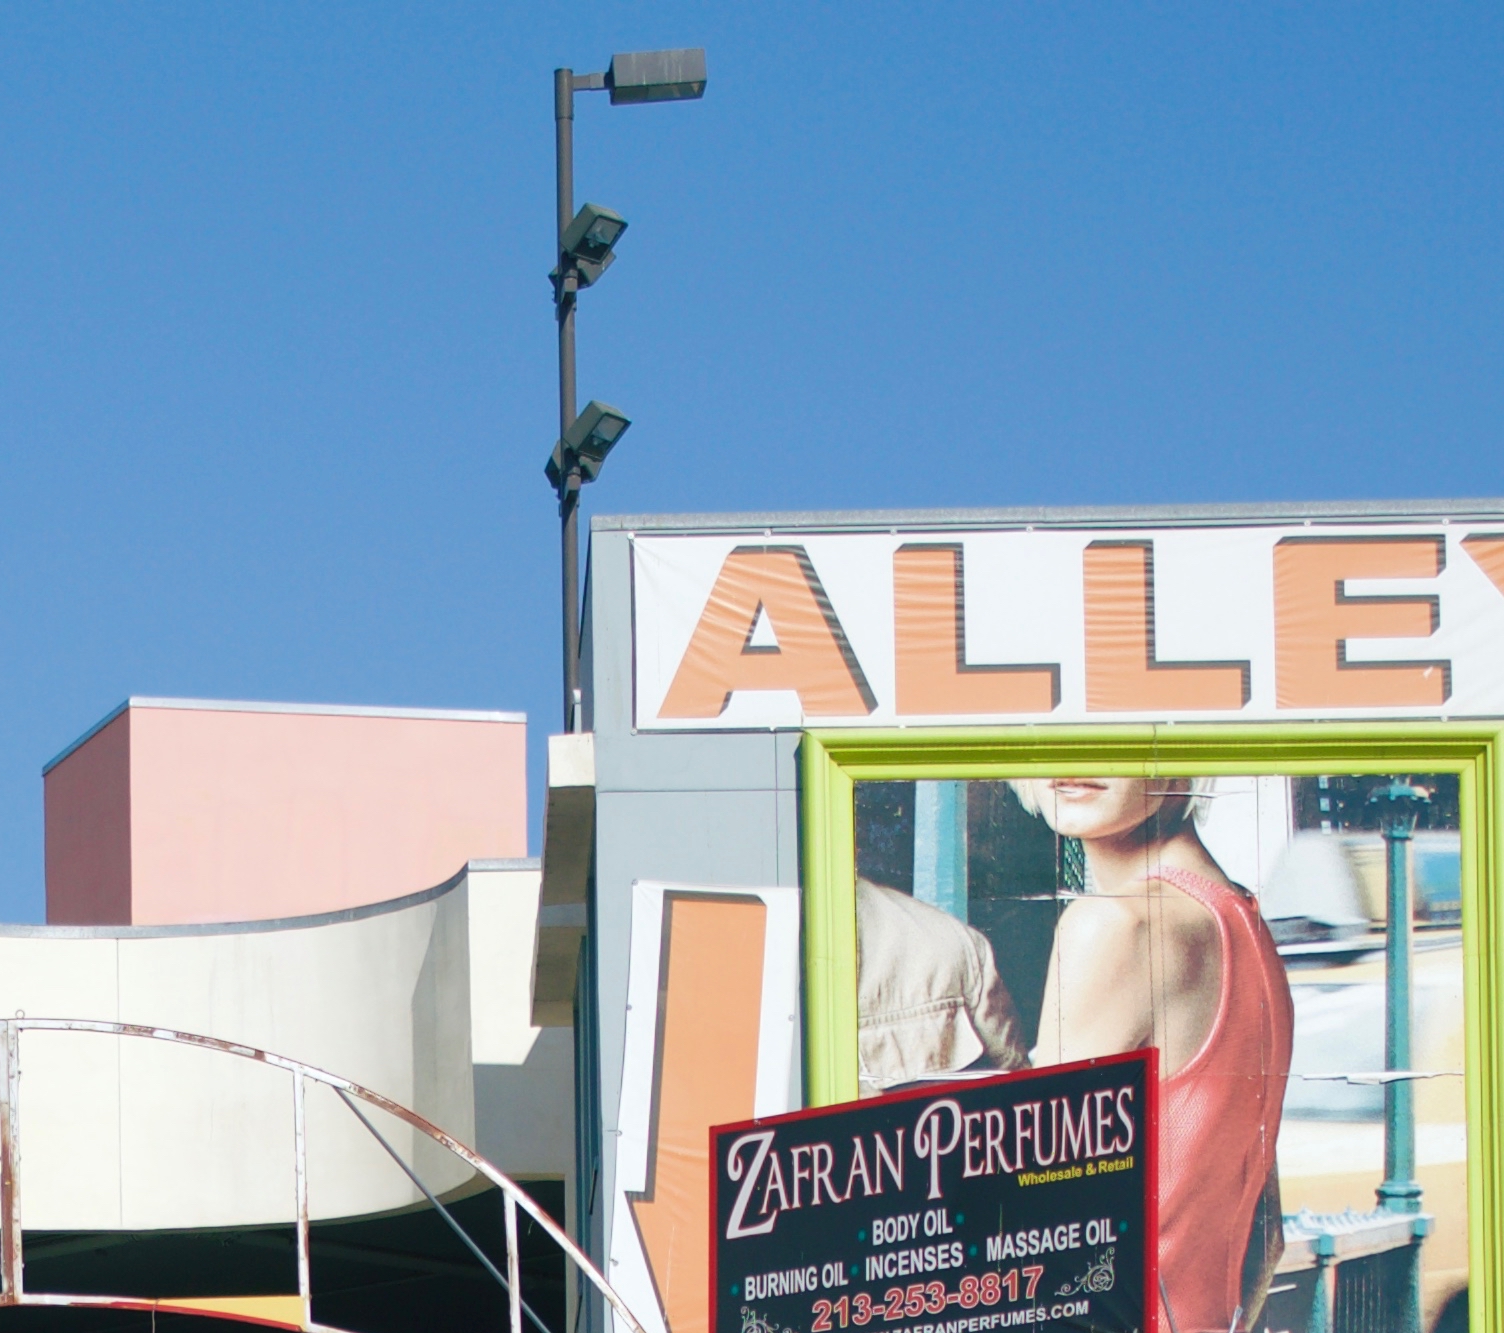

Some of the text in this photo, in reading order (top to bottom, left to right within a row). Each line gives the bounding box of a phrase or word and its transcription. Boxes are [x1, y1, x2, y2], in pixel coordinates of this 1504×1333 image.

[726, 1086, 1135, 1240] ZAFRAN PERFUMES
[1017, 1156, 1134, 1187] Wholesale & Retail
[744, 1217, 1117, 1301] BURNING OIL INCENSES MASSAGE OIL
[872, 1207, 953, 1247] BODY OIL
[811, 1266, 1045, 1333] 213-253-8817
